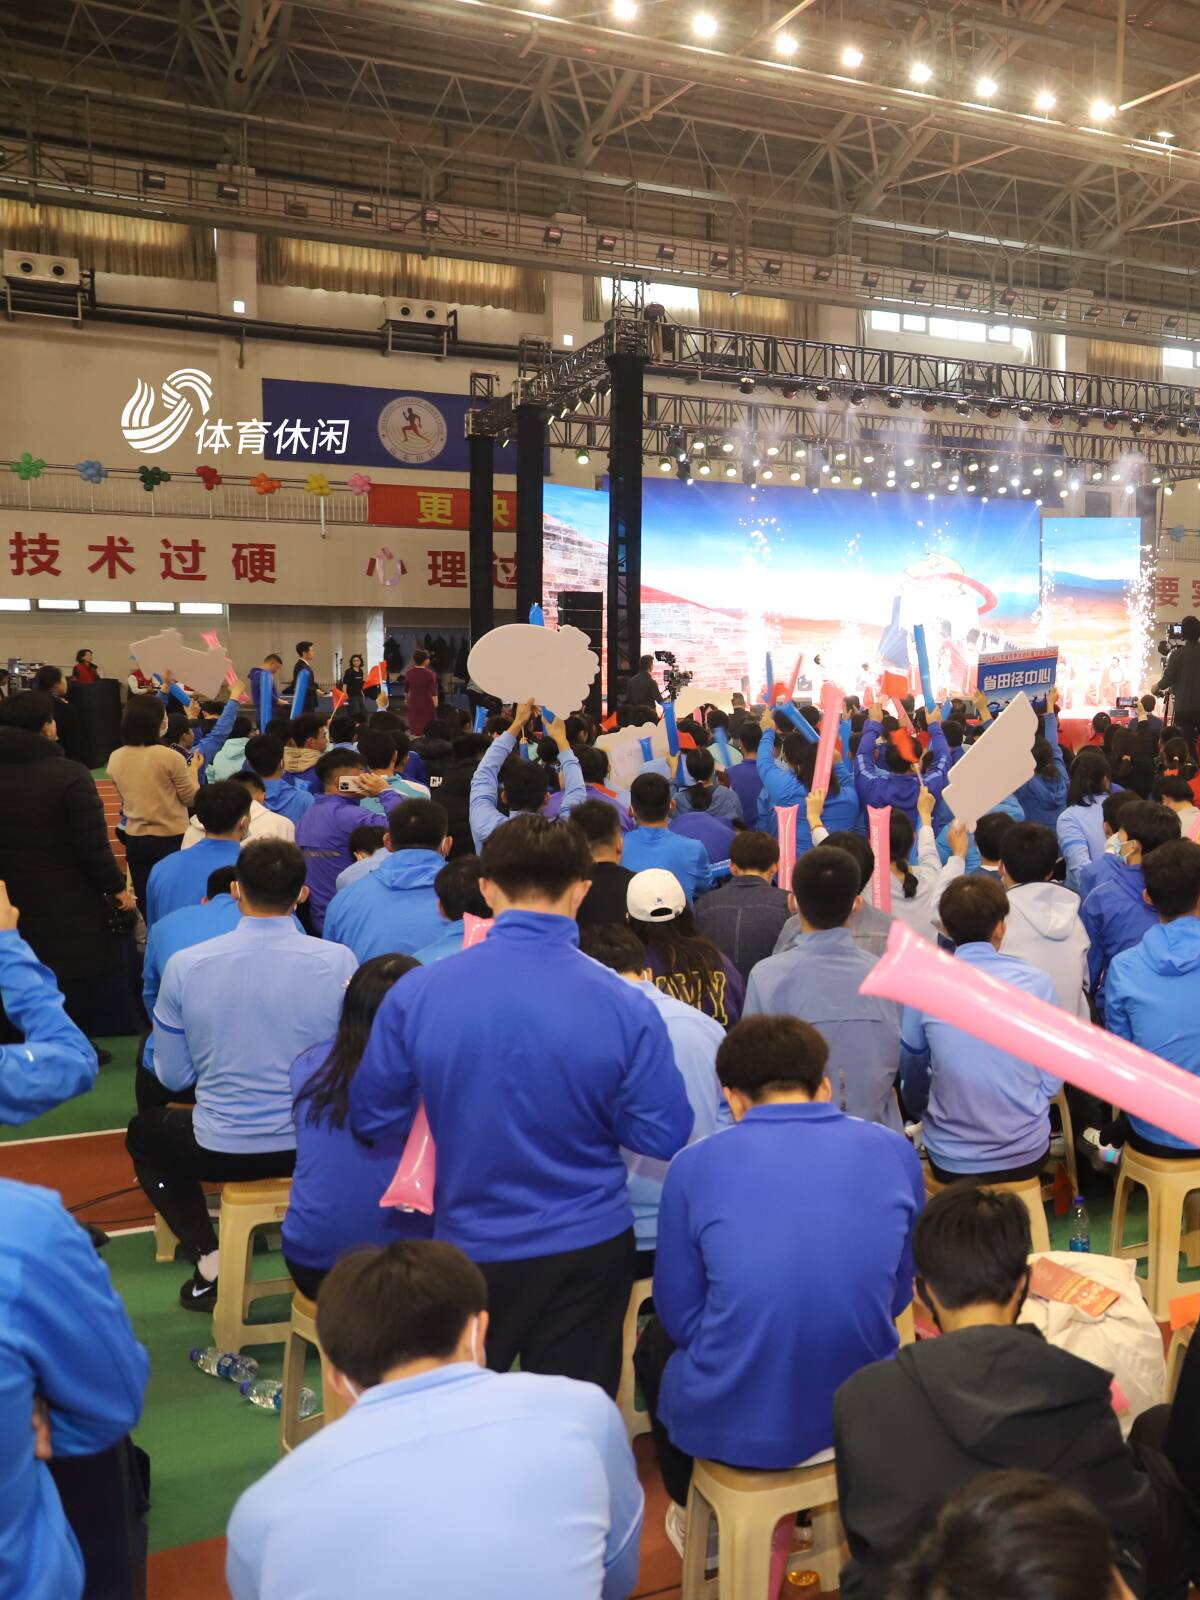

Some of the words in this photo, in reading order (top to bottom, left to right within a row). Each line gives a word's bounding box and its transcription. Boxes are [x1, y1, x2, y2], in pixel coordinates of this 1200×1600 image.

[9, 531, 277, 584] 技术过硬
[983, 667, 1051, 691] 省田径中心
